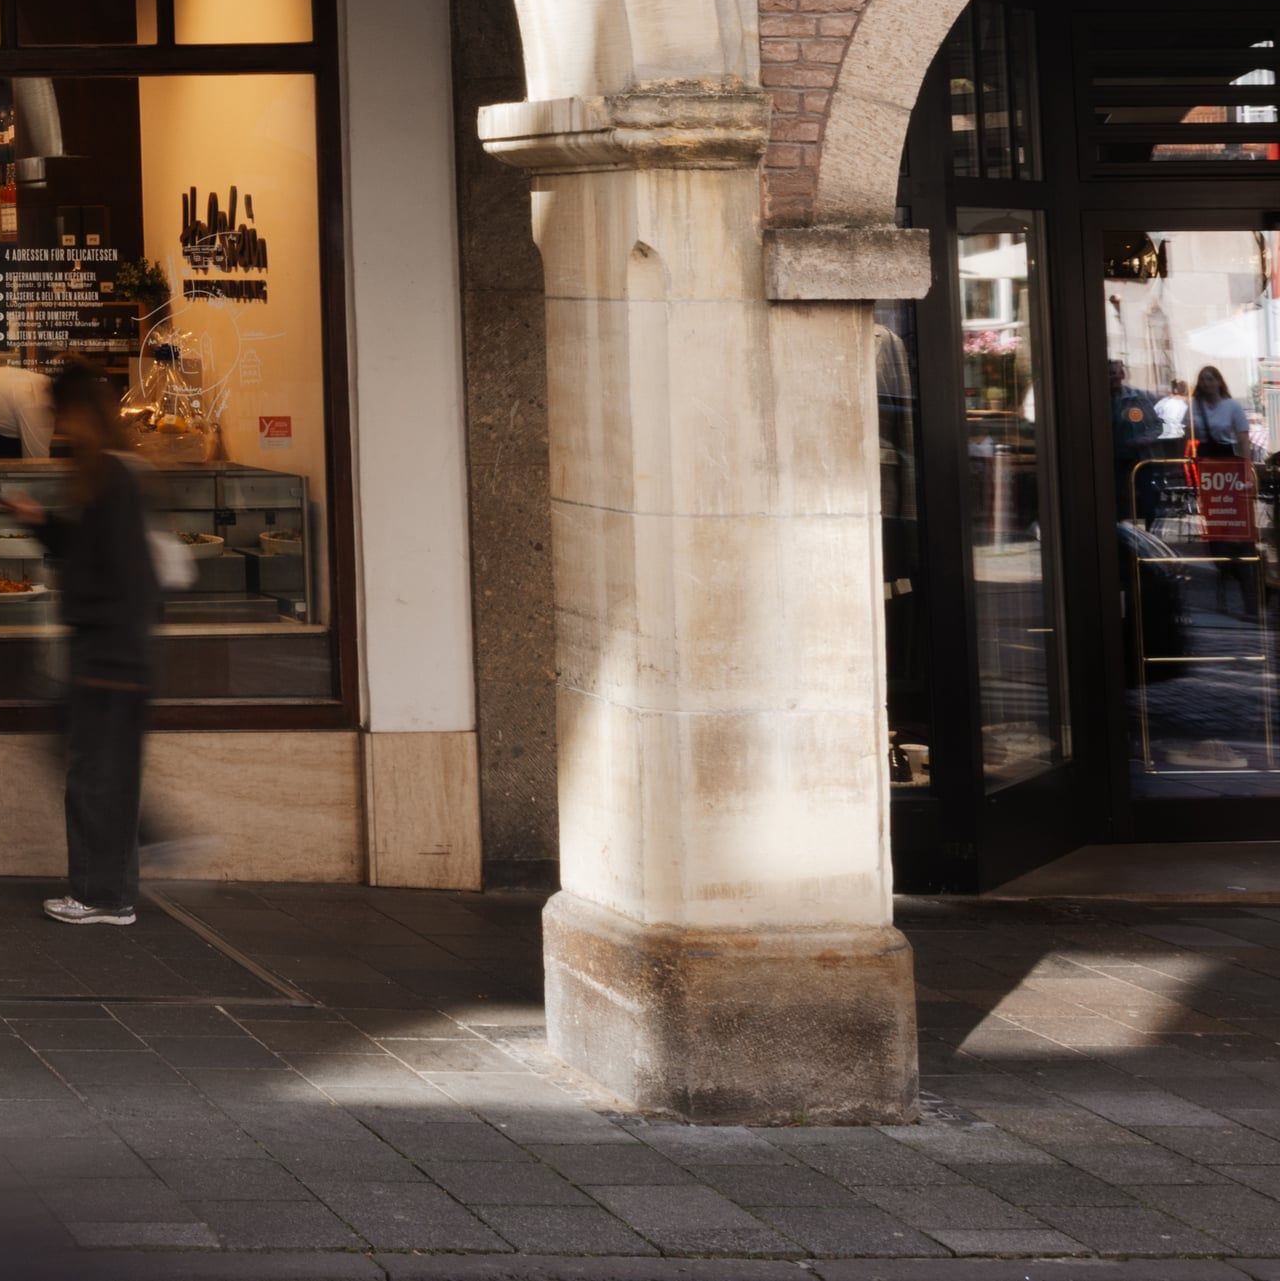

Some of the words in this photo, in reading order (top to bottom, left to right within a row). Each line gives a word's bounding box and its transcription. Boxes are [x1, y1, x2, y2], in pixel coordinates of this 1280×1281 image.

[5, 249, 10, 261] 4
[11, 249, 49, 261] ADRESSEN
[50, 248, 65, 261] FÜR
[66, 249, 118, 261] DELICATESSEN
[1200, 472, 1244, 491] 50%
